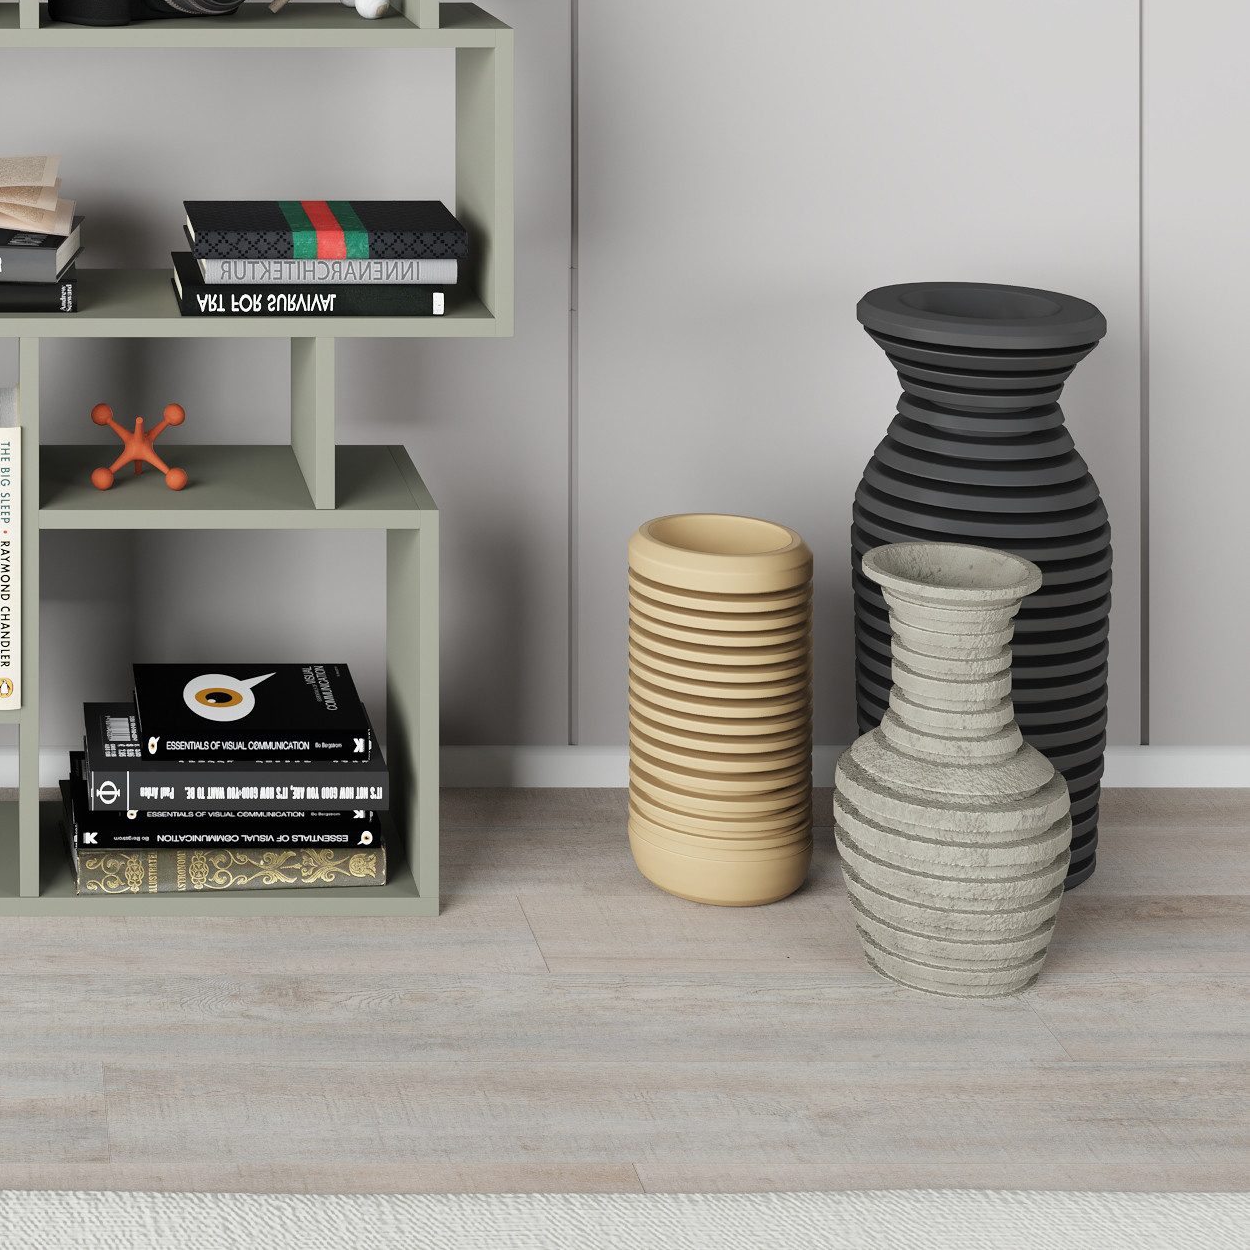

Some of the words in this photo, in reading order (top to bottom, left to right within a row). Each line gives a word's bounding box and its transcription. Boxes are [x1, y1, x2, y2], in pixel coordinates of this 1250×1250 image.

[0, 441, 10, 462] THE
[0, 467, 10, 487] BIG
[0, 491, 10, 524] SLEEP
[0, 540, 10, 601] RAYMOND
[0, 604, 10, 668] CHANDLER
[166, 740, 209, 751] ESSENTIALS
[210, 741, 221, 751] OF
[221, 741, 247, 751] VISUAL
[248, 741, 310, 751] COMMUNICATION
[156, 834, 239, 843] COMMUNICATION
[241, 834, 274, 843] VISUAL
[275, 834, 289, 843] OF
[291, 834, 349, 843] ESSENTIALS
